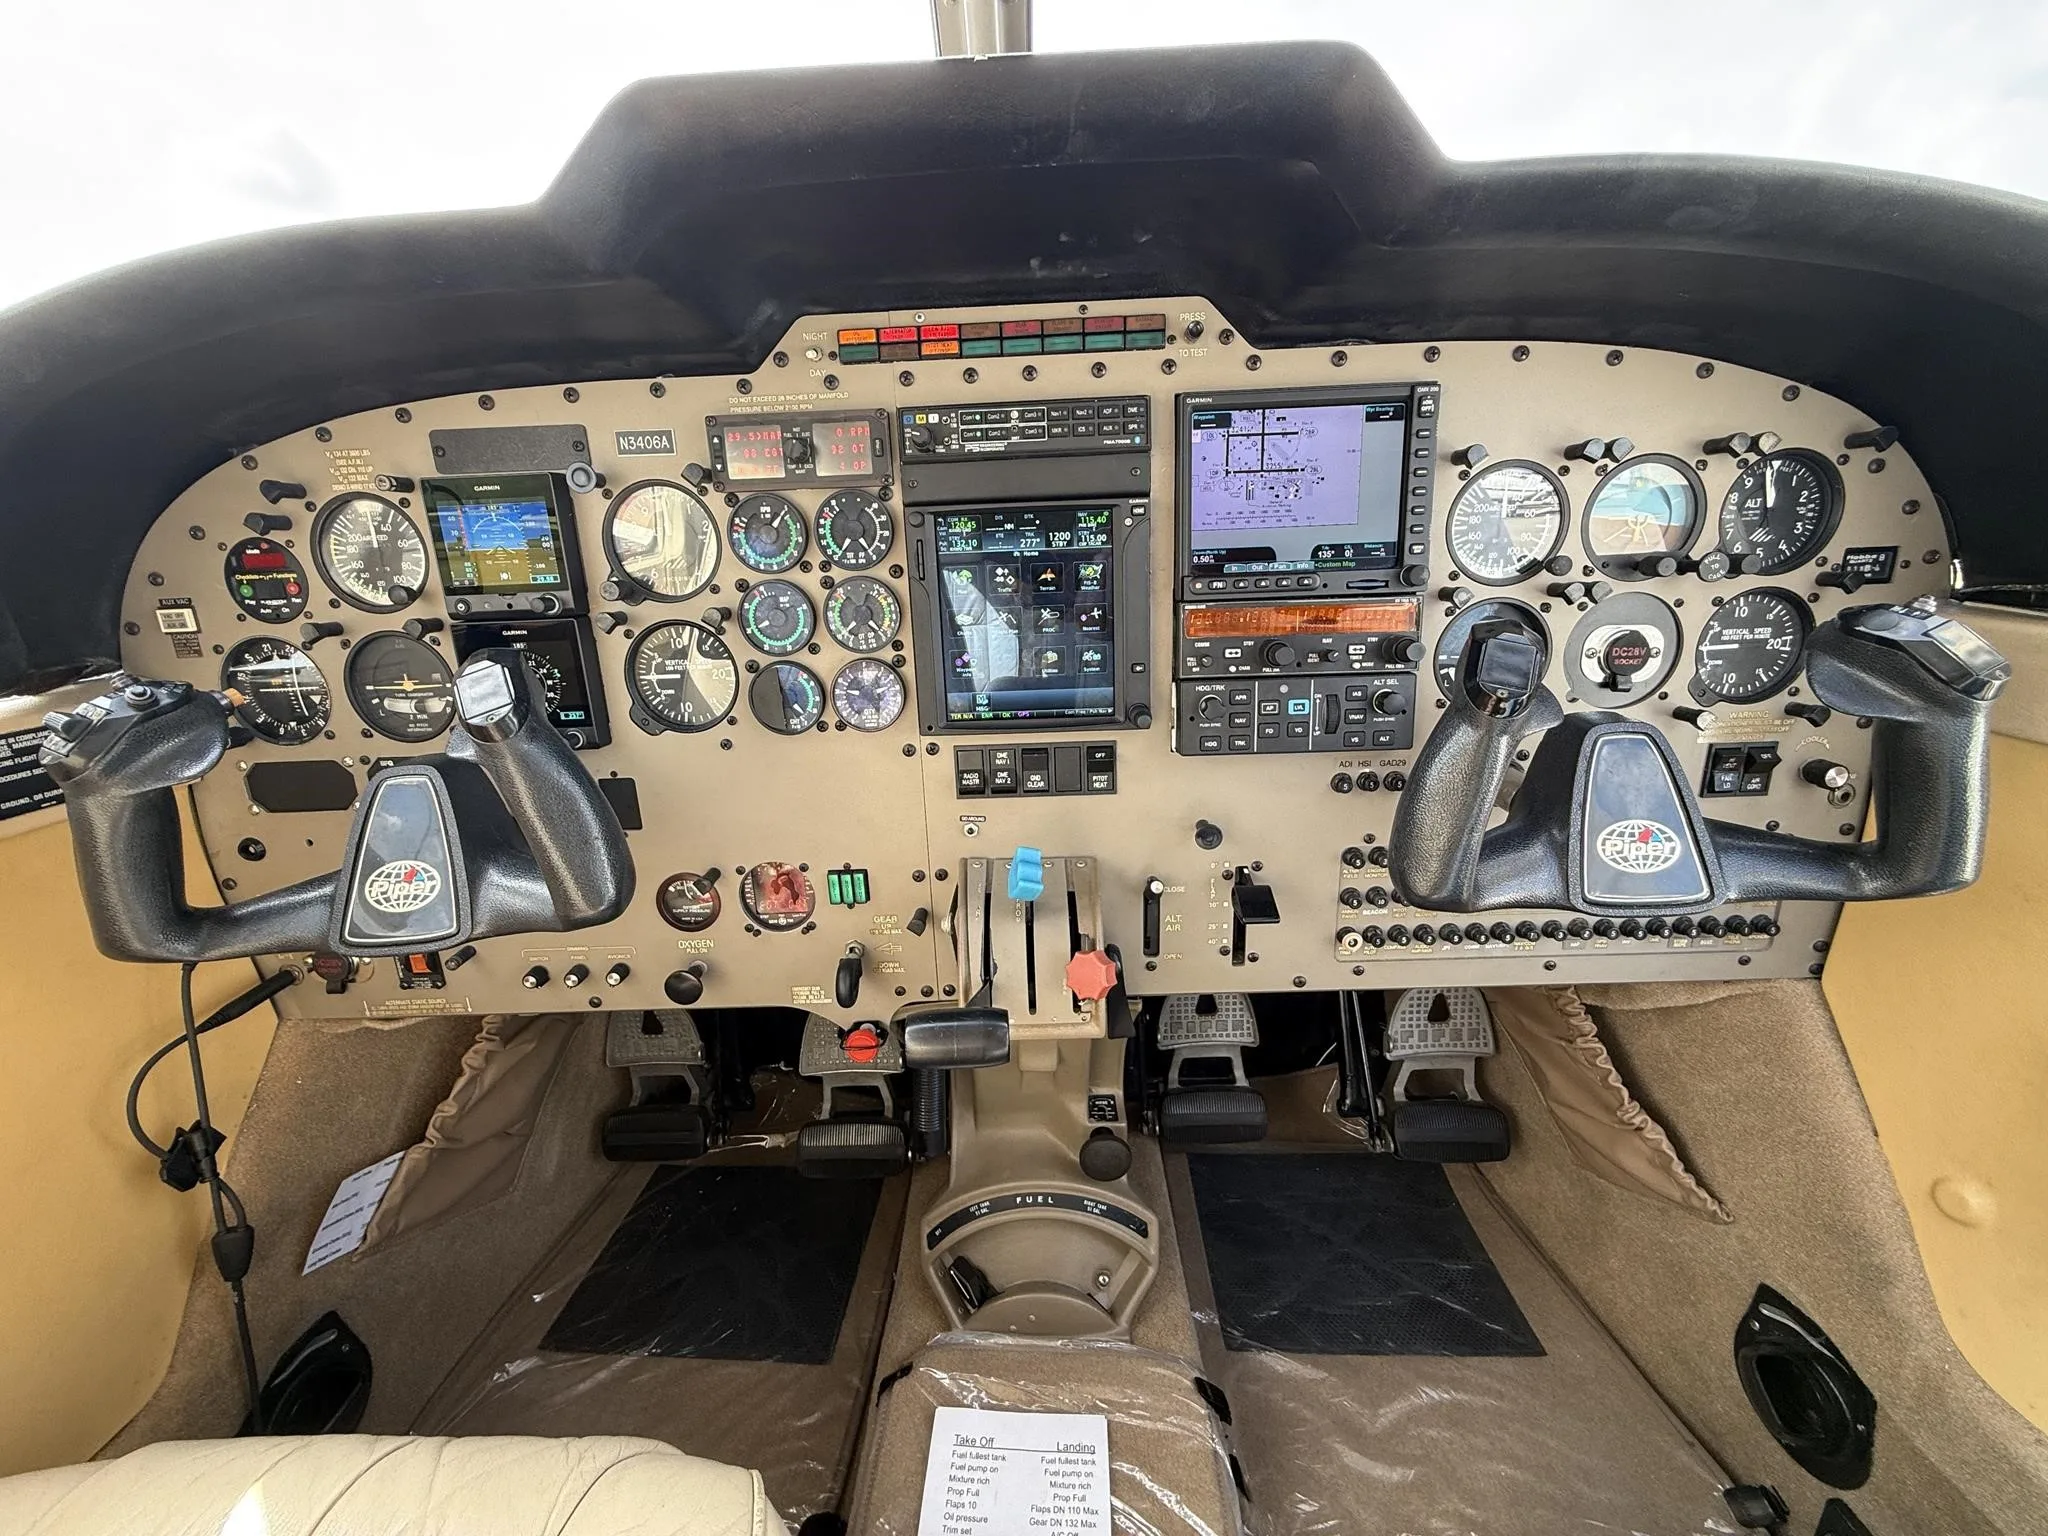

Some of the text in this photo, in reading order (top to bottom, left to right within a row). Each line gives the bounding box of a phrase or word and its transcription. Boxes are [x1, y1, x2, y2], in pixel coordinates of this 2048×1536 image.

[1180, 312, 1206, 320] PRESS
[803, 333, 827, 341] NIGHT
[810, 369, 826, 377] DAY
[620, 437, 670, 450] N3406A
[1745, 478, 1753, 488] 9
[1799, 492, 1808, 502] 2
[1745, 499, 1762, 508] ALT
[1793, 522, 1803, 533] 3
[1049, 532, 1070, 541] 1200
[1081, 534, 1107, 542] 115.00
[1507, 546, 1520, 555] 100
[1734, 542, 1742, 554] 6
[1735, 606, 1748, 618] 10
[670, 637, 683, 649] 10
[1766, 639, 1781, 649] 20
[1612, 647, 1647, 657] DC28V
[712, 669, 726, 679] 20
[1723, 673, 1736, 683] 10
[681, 702, 693, 713] 10
[1604, 838, 1678, 857] Piper
[370, 878, 438, 900] Piper
[1165, 924, 1181, 932] AIR
[678, 940, 714, 949] OXYGEN
[1016, 1195, 1054, 1204] FUEL
[954, 1434, 995, 1447] Take Off
[1056, 1442, 1096, 1454] Landing
[952, 1450, 1006, 1462] Fuel fullest tank
[1041, 1456, 1096, 1466] Fuel fullest tank
[951, 1463, 966, 1471] Fuel
[967, 1465, 988, 1474] pump
[1044, 1468, 1060, 1477] Fuel
[1062, 1470, 1082, 1478] pump
[949, 1475, 990, 1485] Mixture rich
[1050, 1481, 1092, 1490] Mixture rich
[947, 1487, 979, 1497] Prop Full
[1053, 1493, 1086, 1502] Prop Full
[945, 1500, 977, 1510] Flaps 10
[1031, 1504, 1051, 1514] Flaps
[1053, 1505, 1065, 1514] DN
[1083, 1507, 1099, 1515] Max
[944, 1512, 988, 1524] Oil pressure
[1029, 1517, 1048, 1526] Gear
[1050, 1518, 1062, 1526] DN
[1081, 1520, 1096, 1528] Max
[942, 1525, 972, 1535] Trim set
